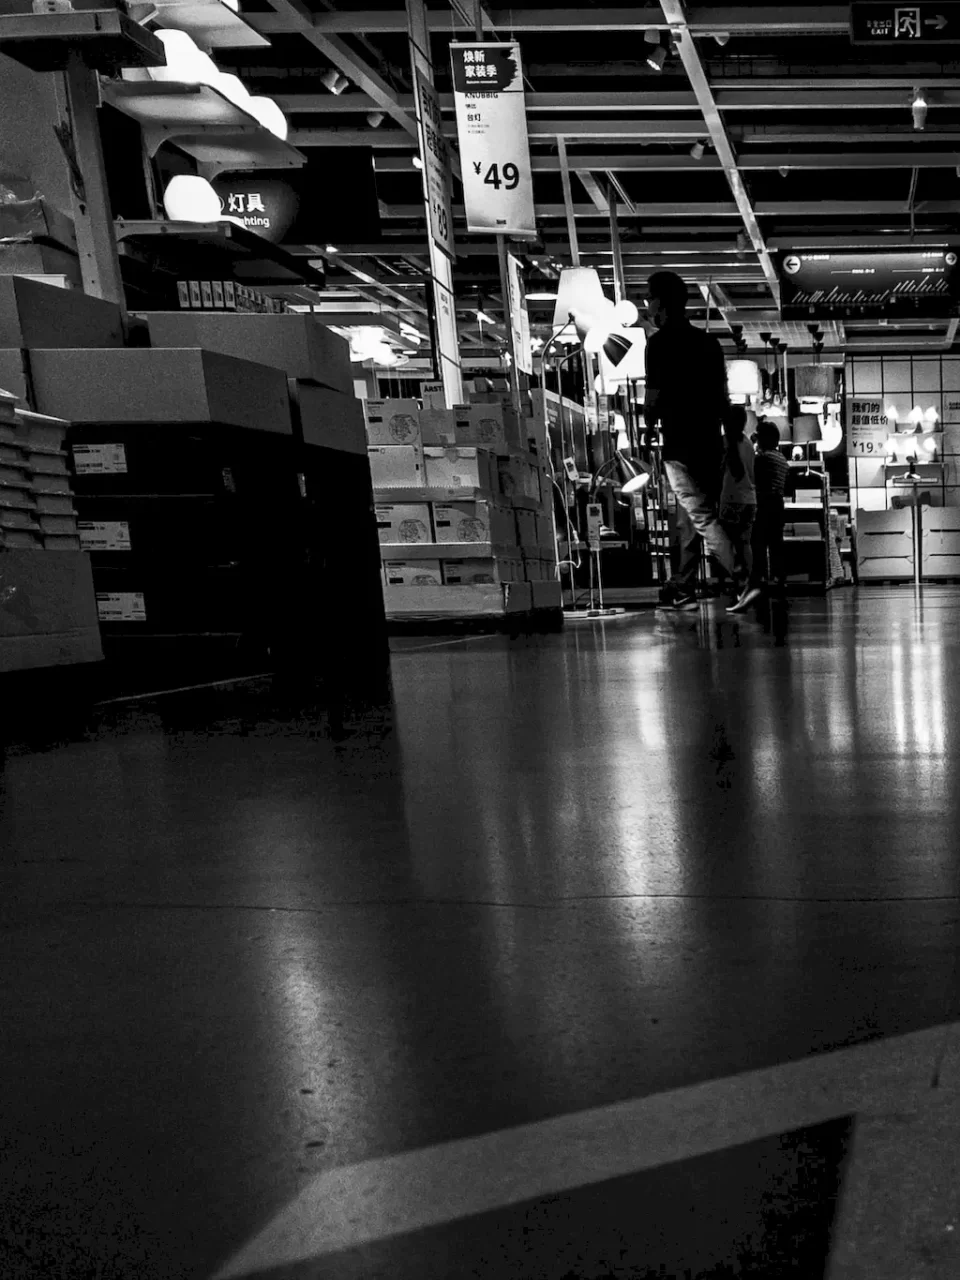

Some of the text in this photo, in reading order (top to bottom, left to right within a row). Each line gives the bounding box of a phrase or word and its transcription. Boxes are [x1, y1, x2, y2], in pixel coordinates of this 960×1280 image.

[464, 65, 497, 77] 家装季
[473, 162, 520, 190] ¥49
[228, 192, 265, 213] 灯具
[424, 384, 443, 392] ÅRST
[851, 402, 880, 413] 我们的
[851, 415, 889, 425] 超值低价
